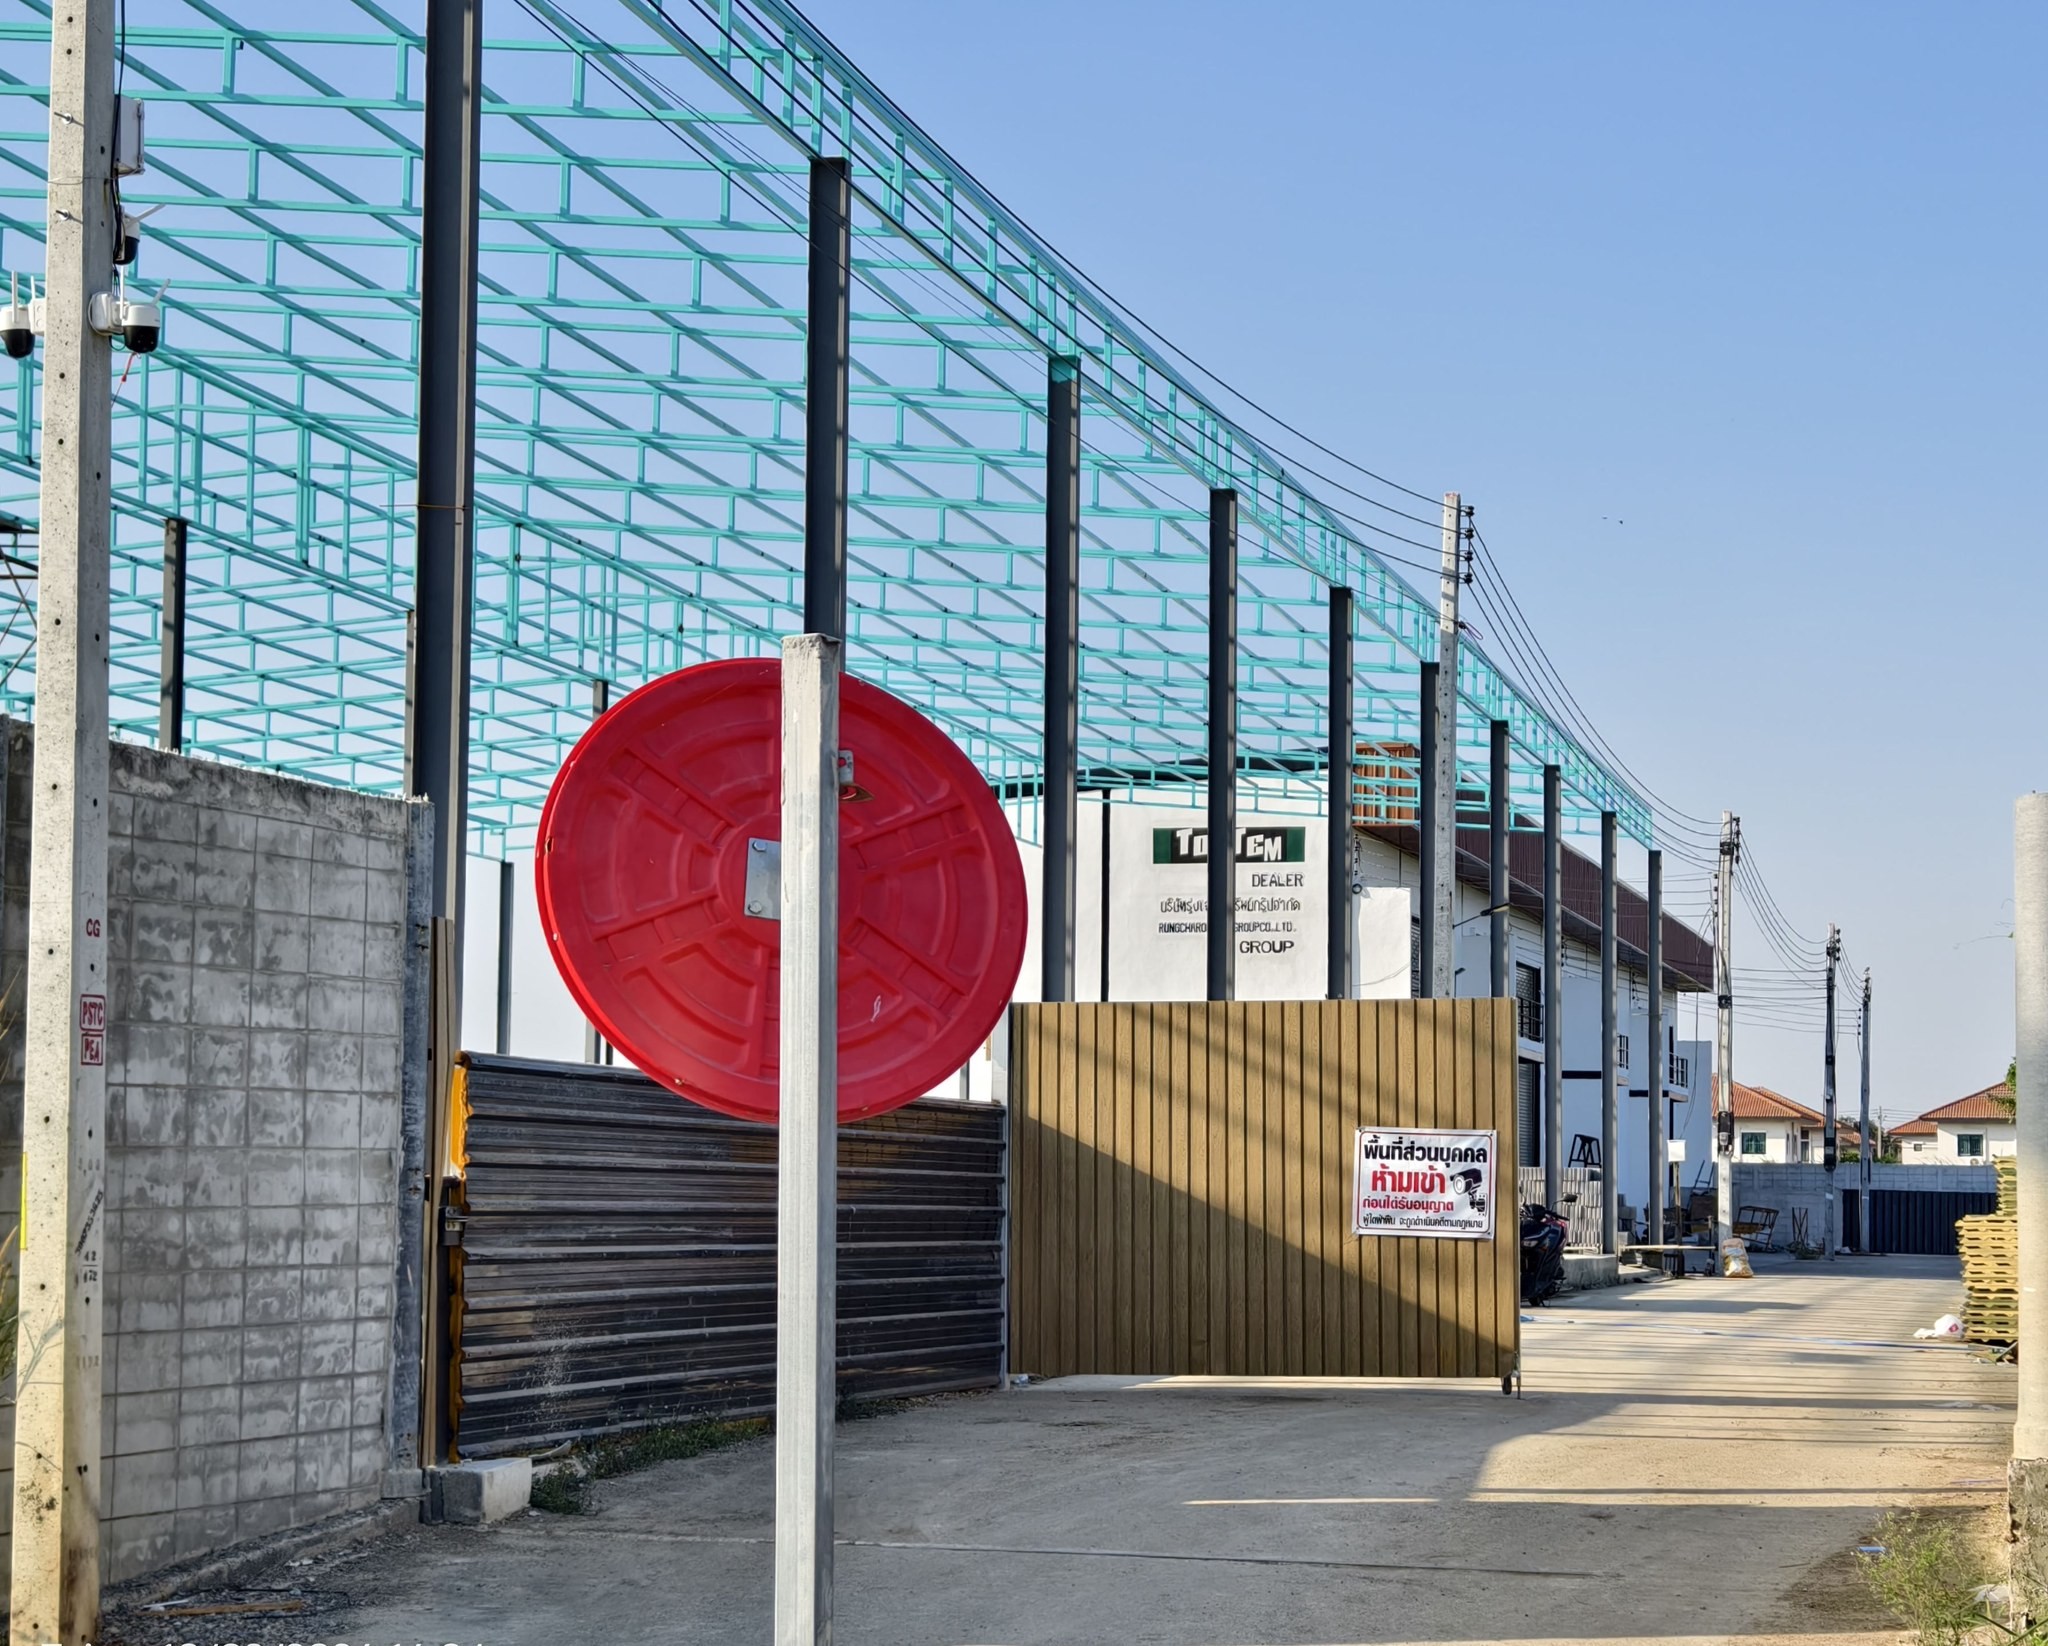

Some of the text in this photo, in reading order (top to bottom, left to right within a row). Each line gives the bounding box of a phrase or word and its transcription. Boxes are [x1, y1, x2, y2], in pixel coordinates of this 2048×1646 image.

[1176, 828, 1282, 862] TOTEM
[1251, 873, 1304, 888] DEALER
[86, 918, 101, 937] CG
[1158, 922, 1208, 933] RUNGCHARO
[1239, 940, 1295, 954] GROUP
[82, 1001, 103, 1026] PSTC
[84, 1038, 100, 1062] PEA
[1364, 1134, 1488, 1168] พื้นที่ส่วนบุคคล
[1371, 1163, 1446, 1194] ห้ามเข้า
[1363, 1194, 1454, 1214] ก่อนได้รับอนุญาต
